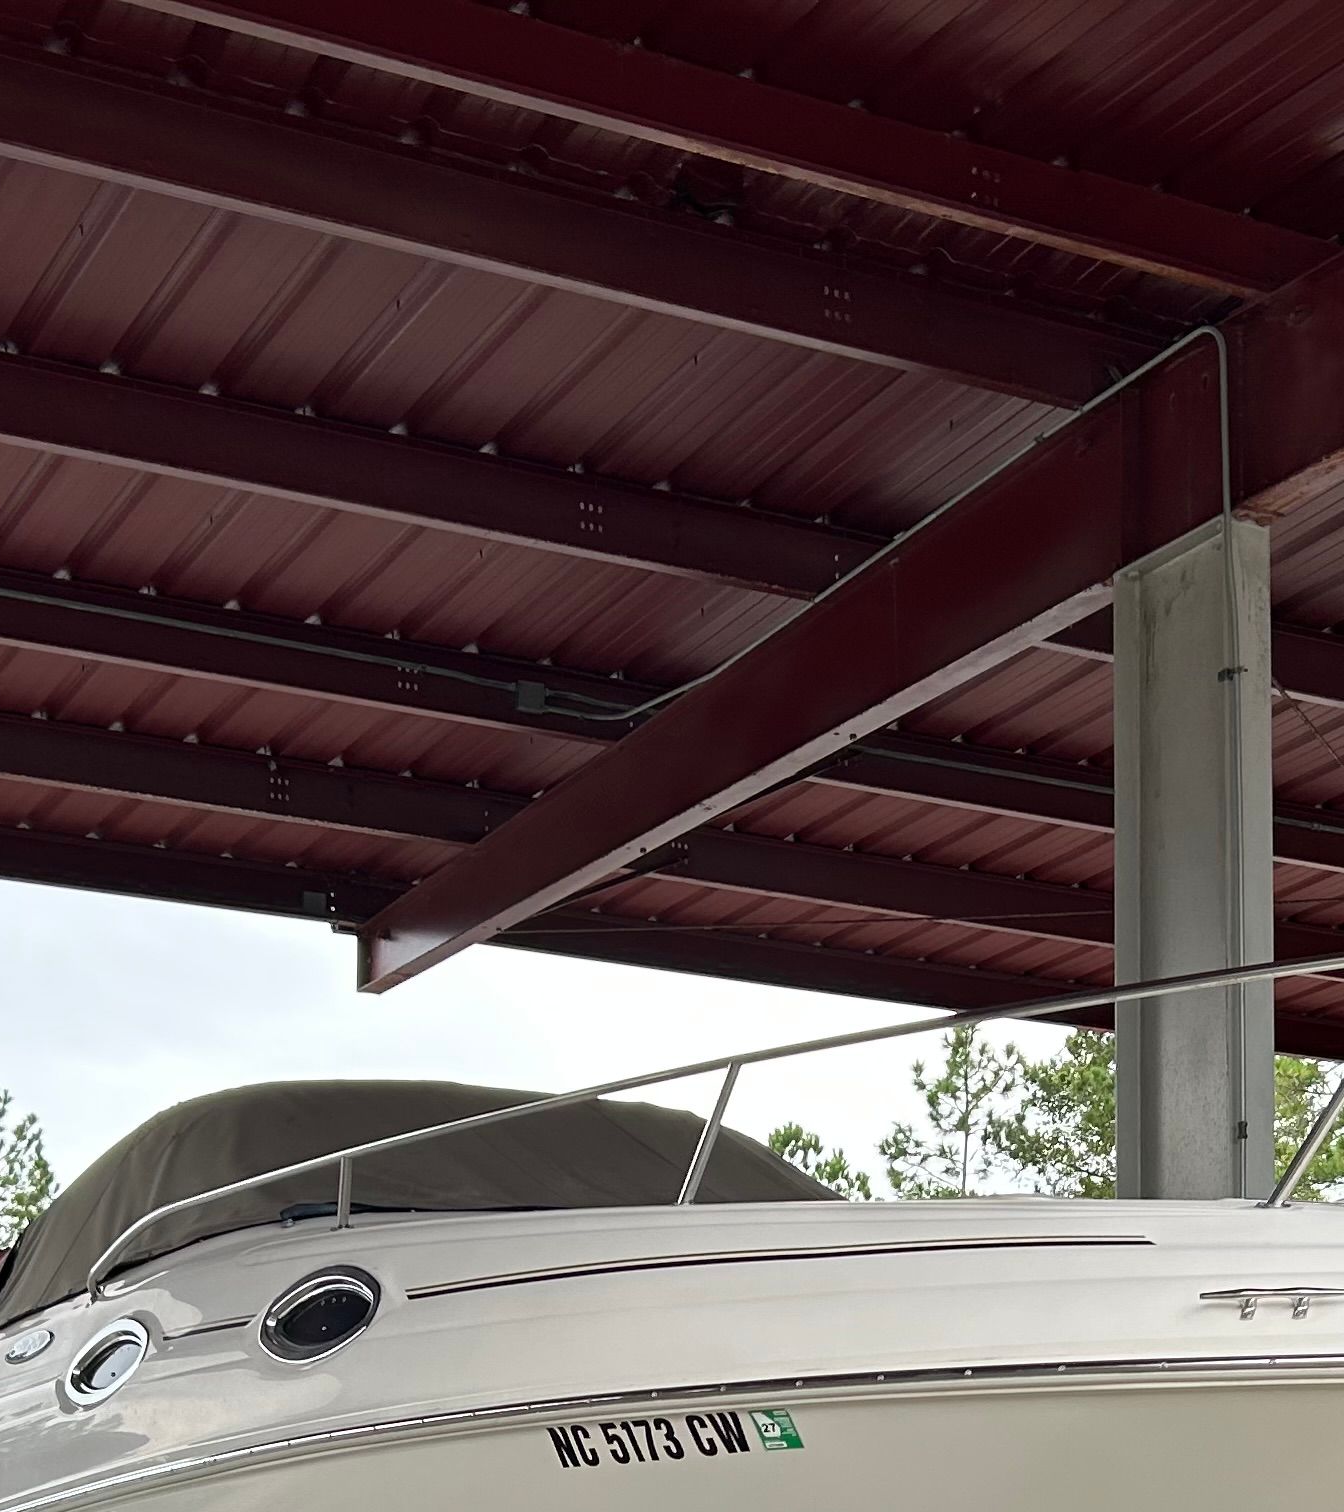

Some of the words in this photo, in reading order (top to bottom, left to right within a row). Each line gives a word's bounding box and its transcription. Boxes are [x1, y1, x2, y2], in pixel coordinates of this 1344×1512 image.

[547, 1425, 600, 1468] NC
[598, 1418, 685, 1465] 5173
[685, 1411, 750, 1456] CW
[761, 1423, 776, 1433] 27
